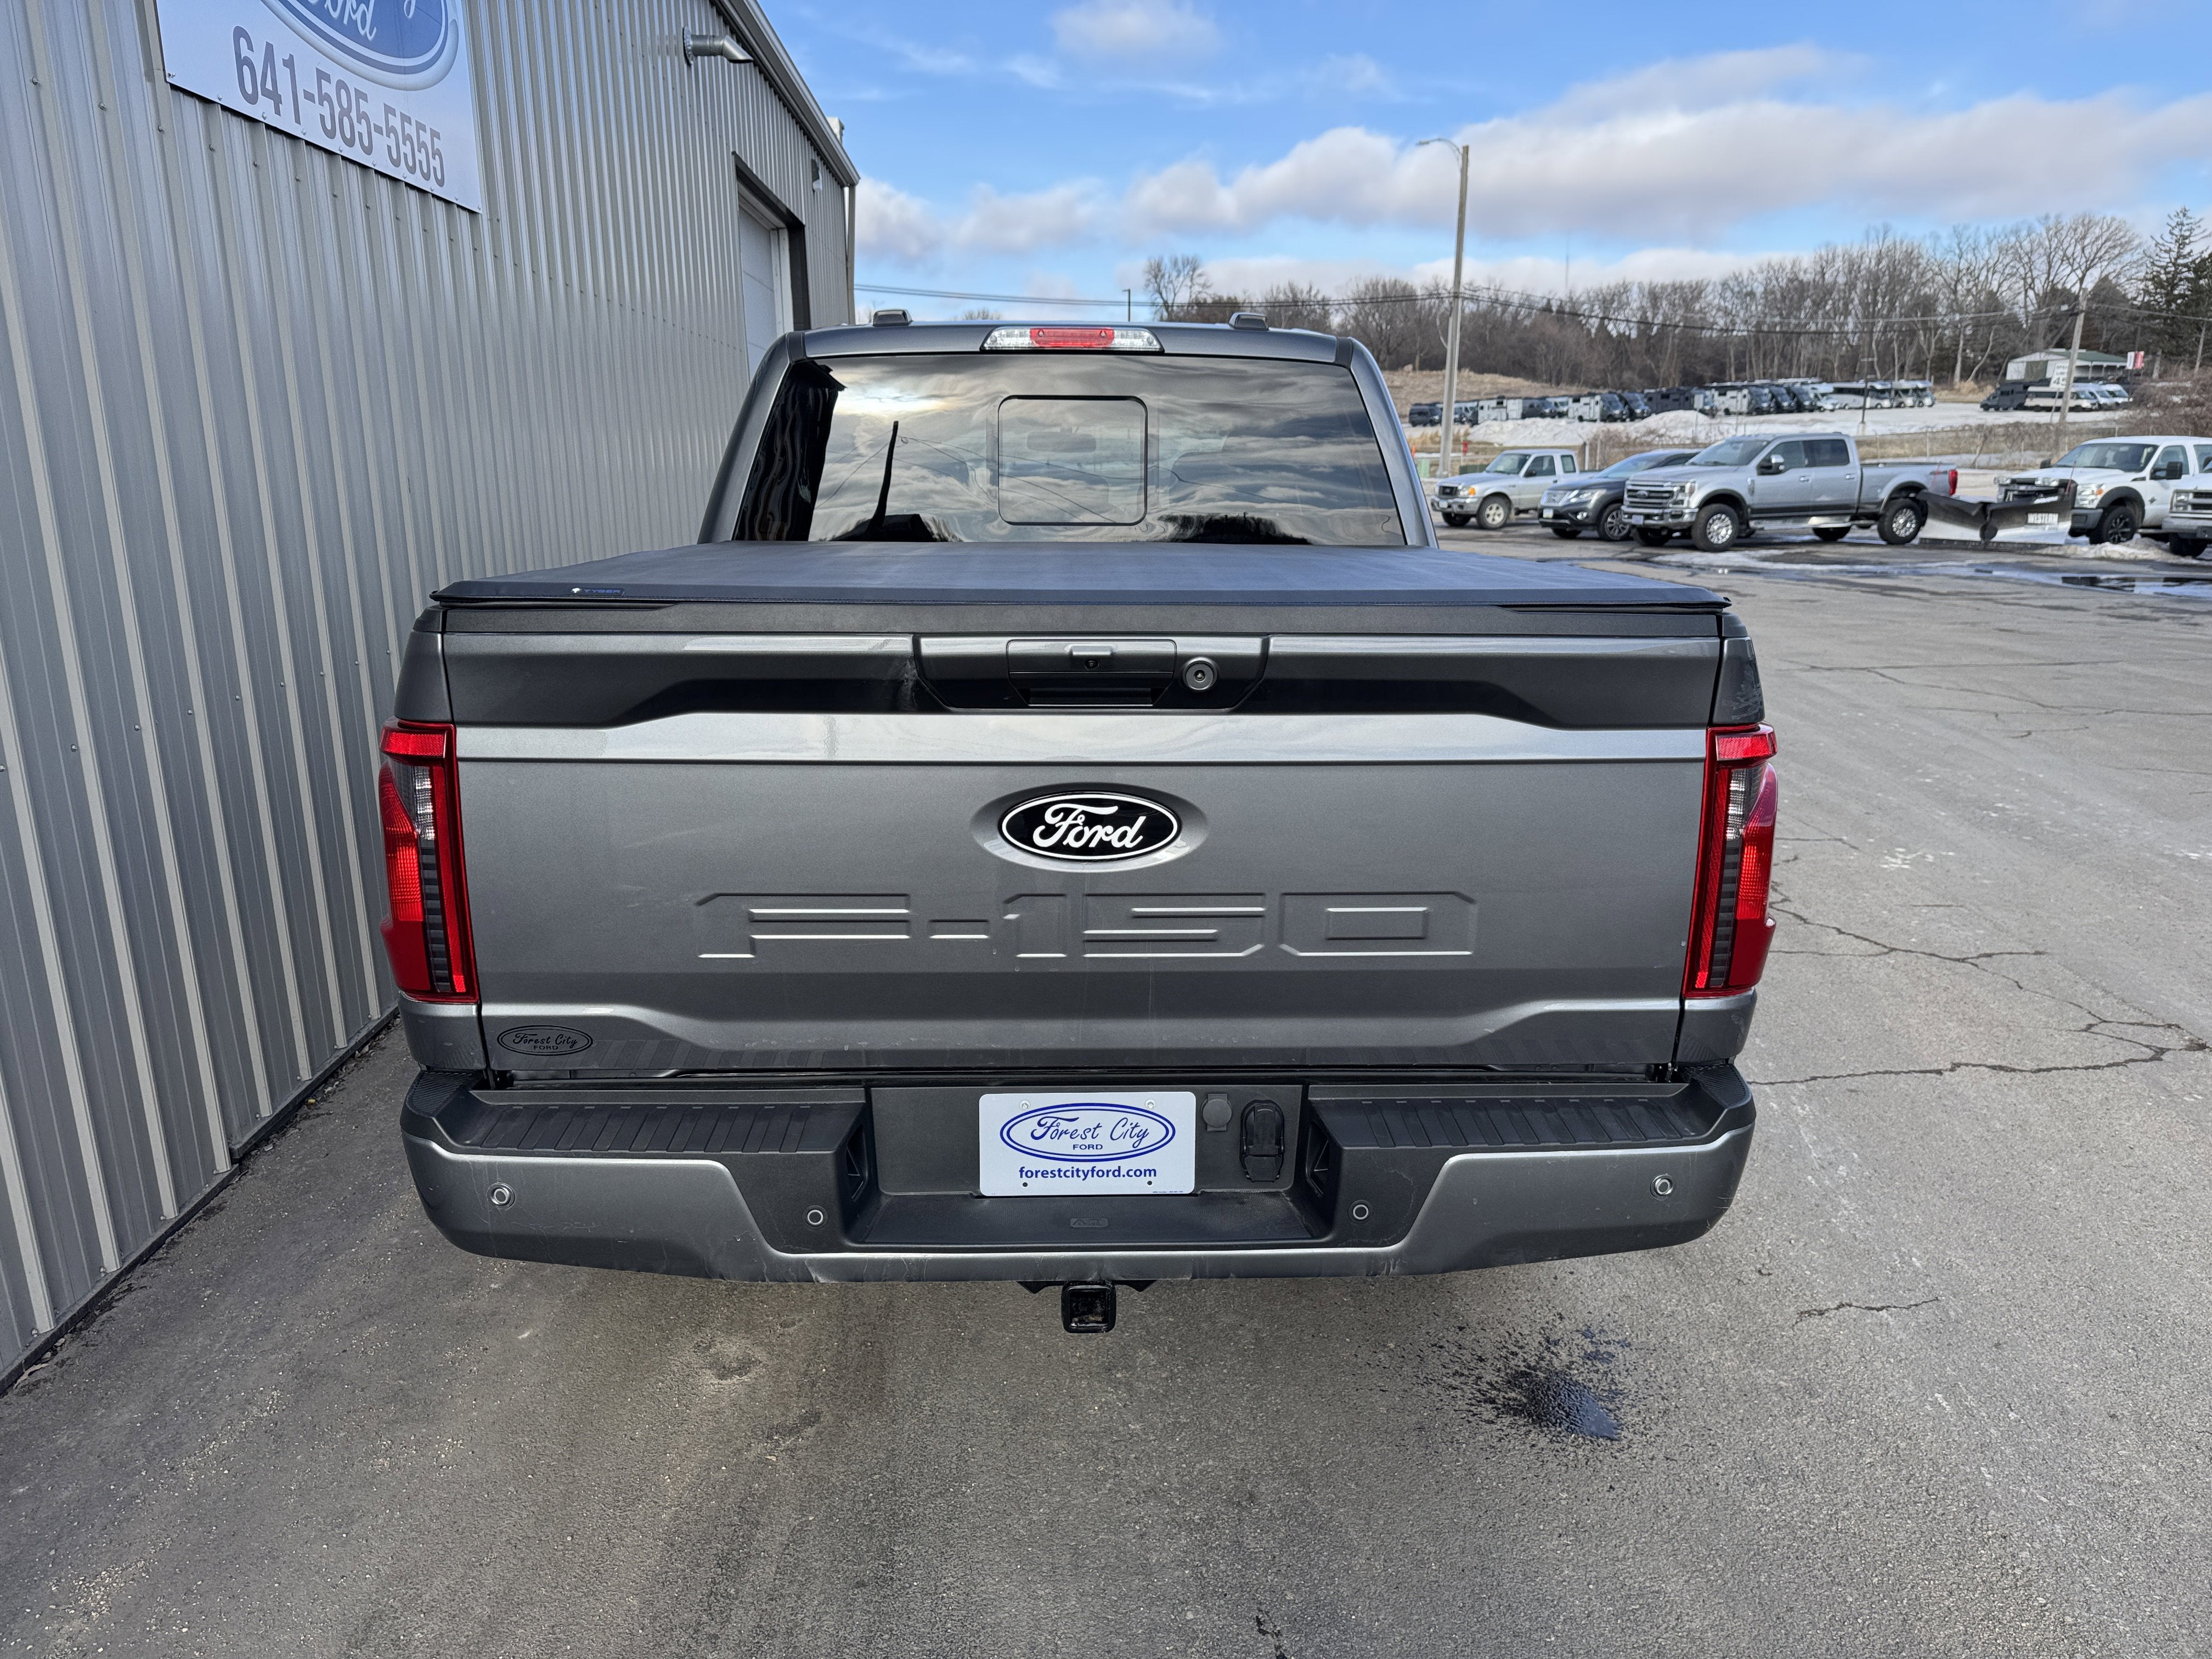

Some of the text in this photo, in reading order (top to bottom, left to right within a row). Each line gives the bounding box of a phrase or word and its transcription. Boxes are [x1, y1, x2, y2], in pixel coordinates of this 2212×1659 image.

[233, 25, 445, 188] 641-585-5555
[1032, 803, 1147, 848] Ford
[694, 893, 1477, 958] F-150
[512, 1032, 578, 1049] Forest City
[1030, 1116, 1150, 1149] Forest City
[1019, 1165, 1157, 1181] forestcityford.com
